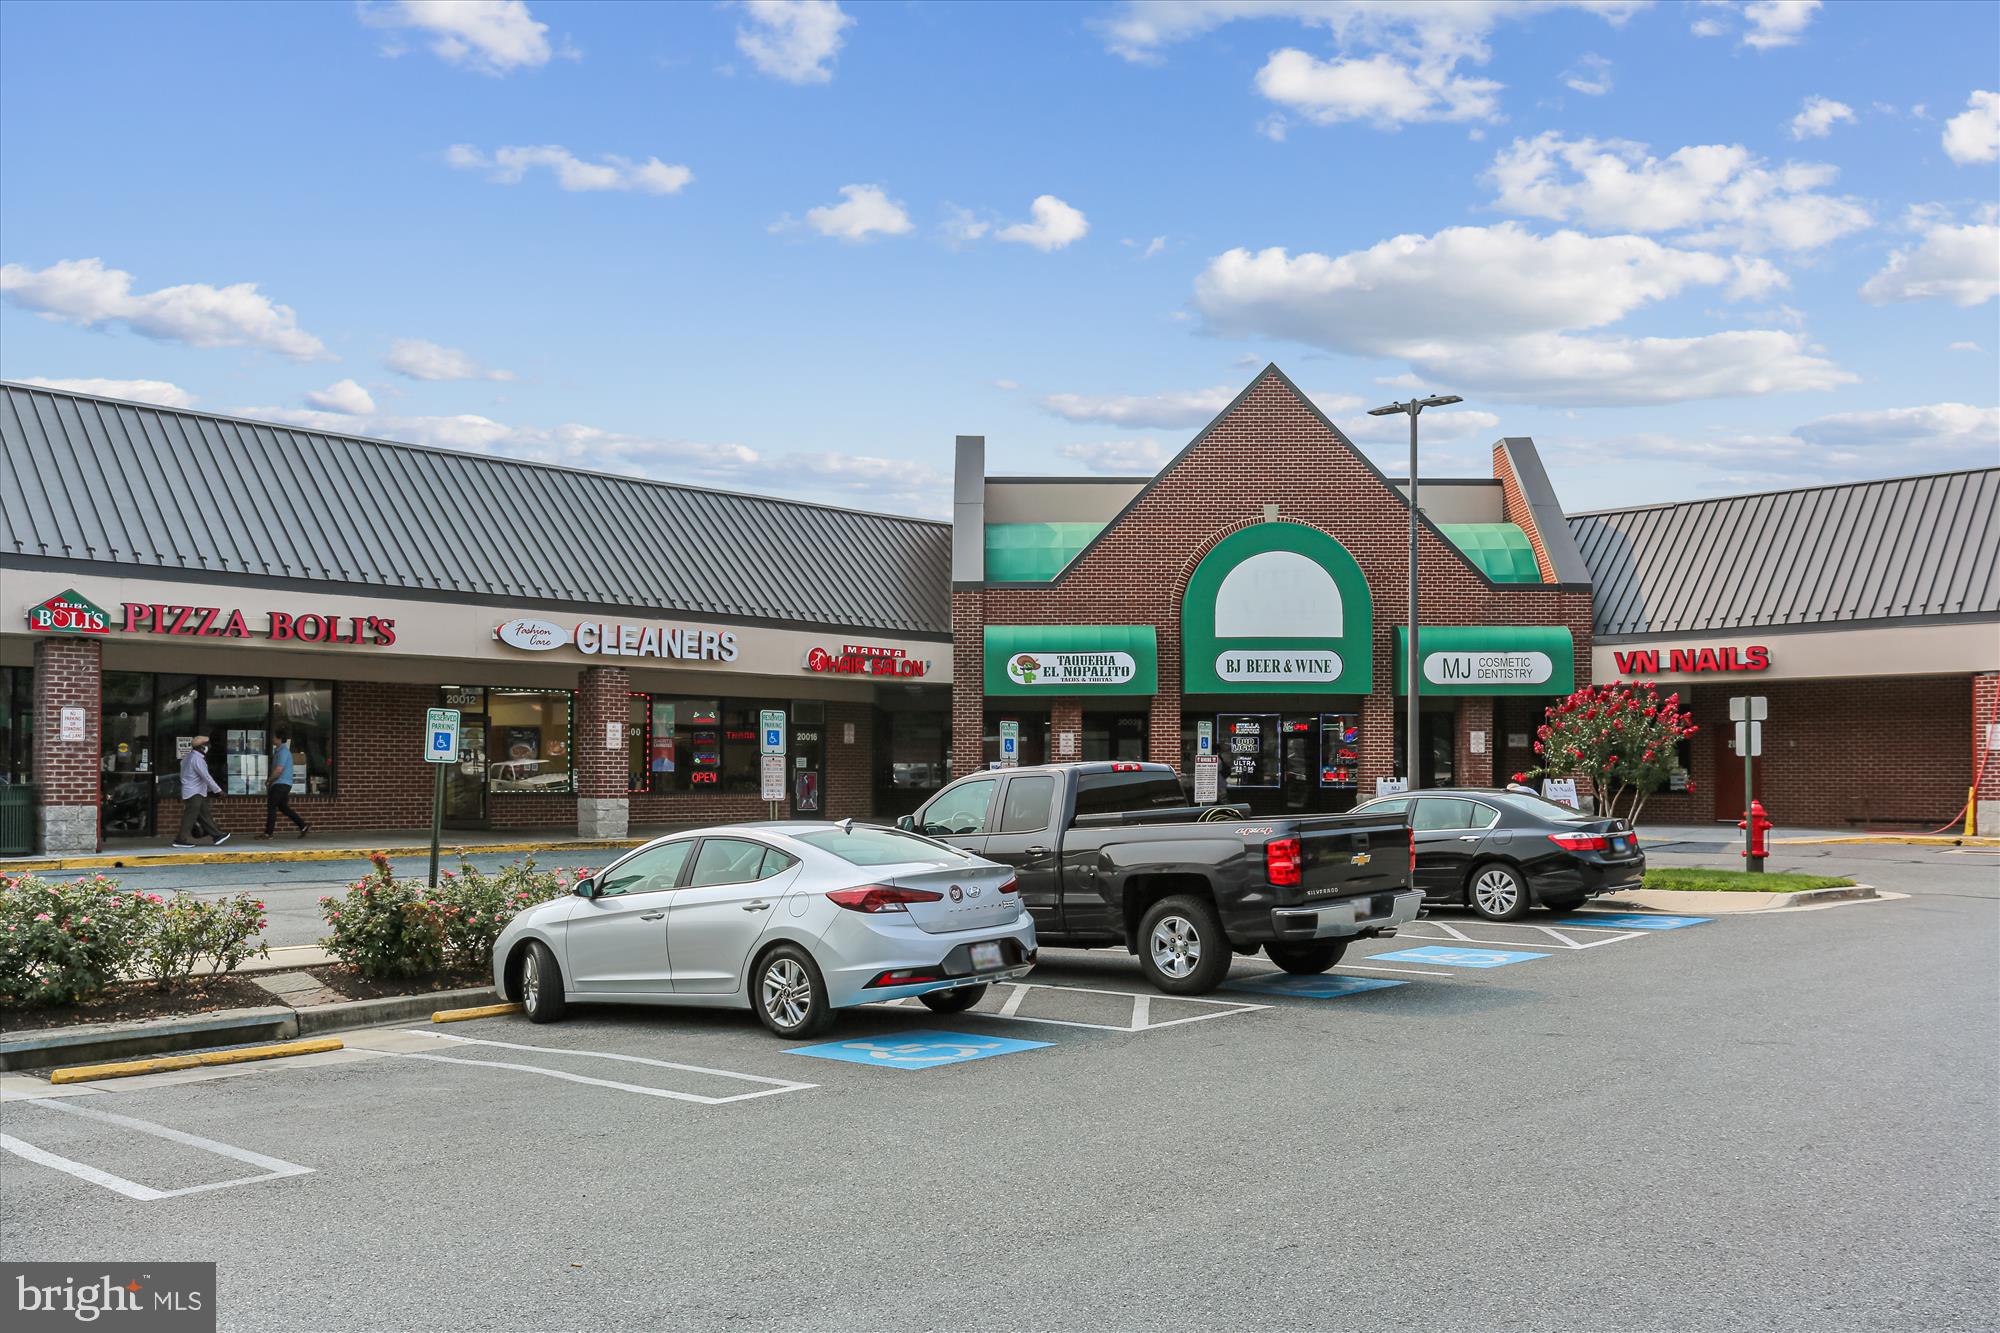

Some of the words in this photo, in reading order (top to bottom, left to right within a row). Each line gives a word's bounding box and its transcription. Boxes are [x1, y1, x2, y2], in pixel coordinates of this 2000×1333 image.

[38, 608, 104, 630] BOLI'S
[119, 602, 253, 639] PIZZA
[266, 611, 397, 647] BOLI'S
[515, 623, 552, 637] Fashion
[529, 635, 552, 646] Care
[574, 621, 740, 663] CLEANERS
[847, 646, 902, 657] MANNA
[1056, 655, 1116, 666] TAQUERIA
[1478, 657, 1531, 667] COSMETIC
[1613, 650, 1660, 675] VN
[1669, 645, 1770, 673] NAILS
[827, 655, 866, 674] HAIR
[871, 657, 924, 677] SALON
[1043, 666, 1060, 677] EL
[1063, 666, 1130, 677] NOPALITO
[1226, 659, 1240, 673] BJ
[1246, 659, 1281, 673] BEER
[1283, 659, 1292, 673] &
[1295, 659, 1332, 673] WINE
[1442, 658, 1471, 679] MJ
[1477, 668, 1533, 679] DENTISTRY
[446, 695, 476, 704] 20012
[430, 714, 457, 722] RESERVED
[692, 772, 717, 783] OPEN
